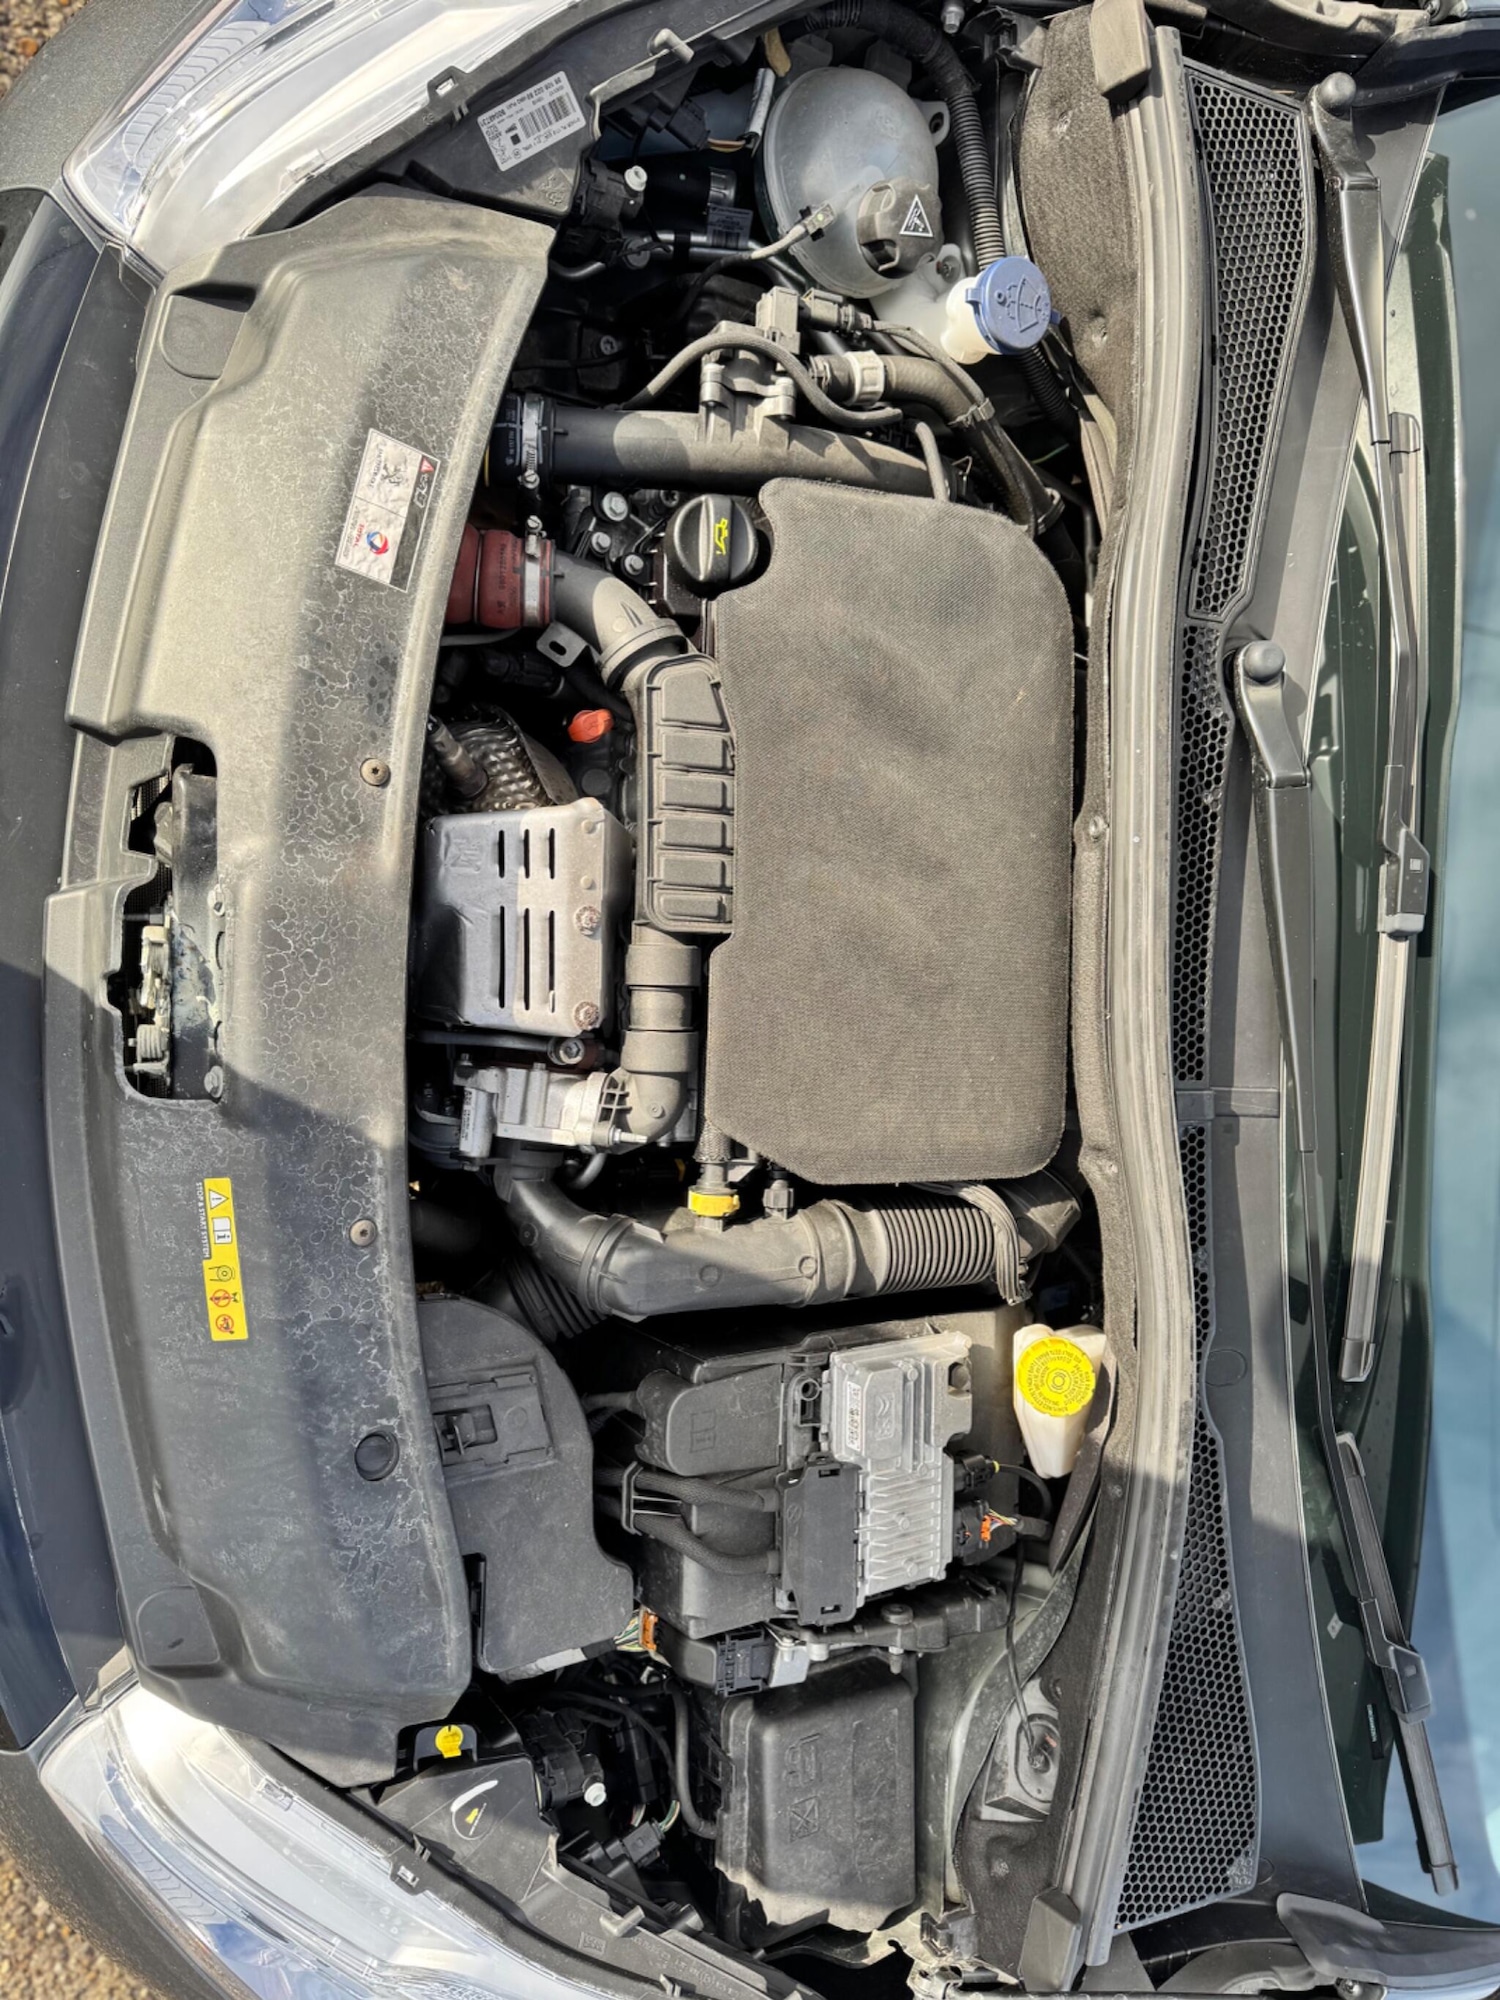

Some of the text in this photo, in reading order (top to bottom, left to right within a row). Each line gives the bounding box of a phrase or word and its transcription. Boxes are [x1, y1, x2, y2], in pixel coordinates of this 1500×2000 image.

[352, 523, 366, 548] TOTAL
[196, 1182, 204, 1199] STOP
[199, 1206, 207, 1227] START
[201, 1228, 210, 1257] SYSTEM
